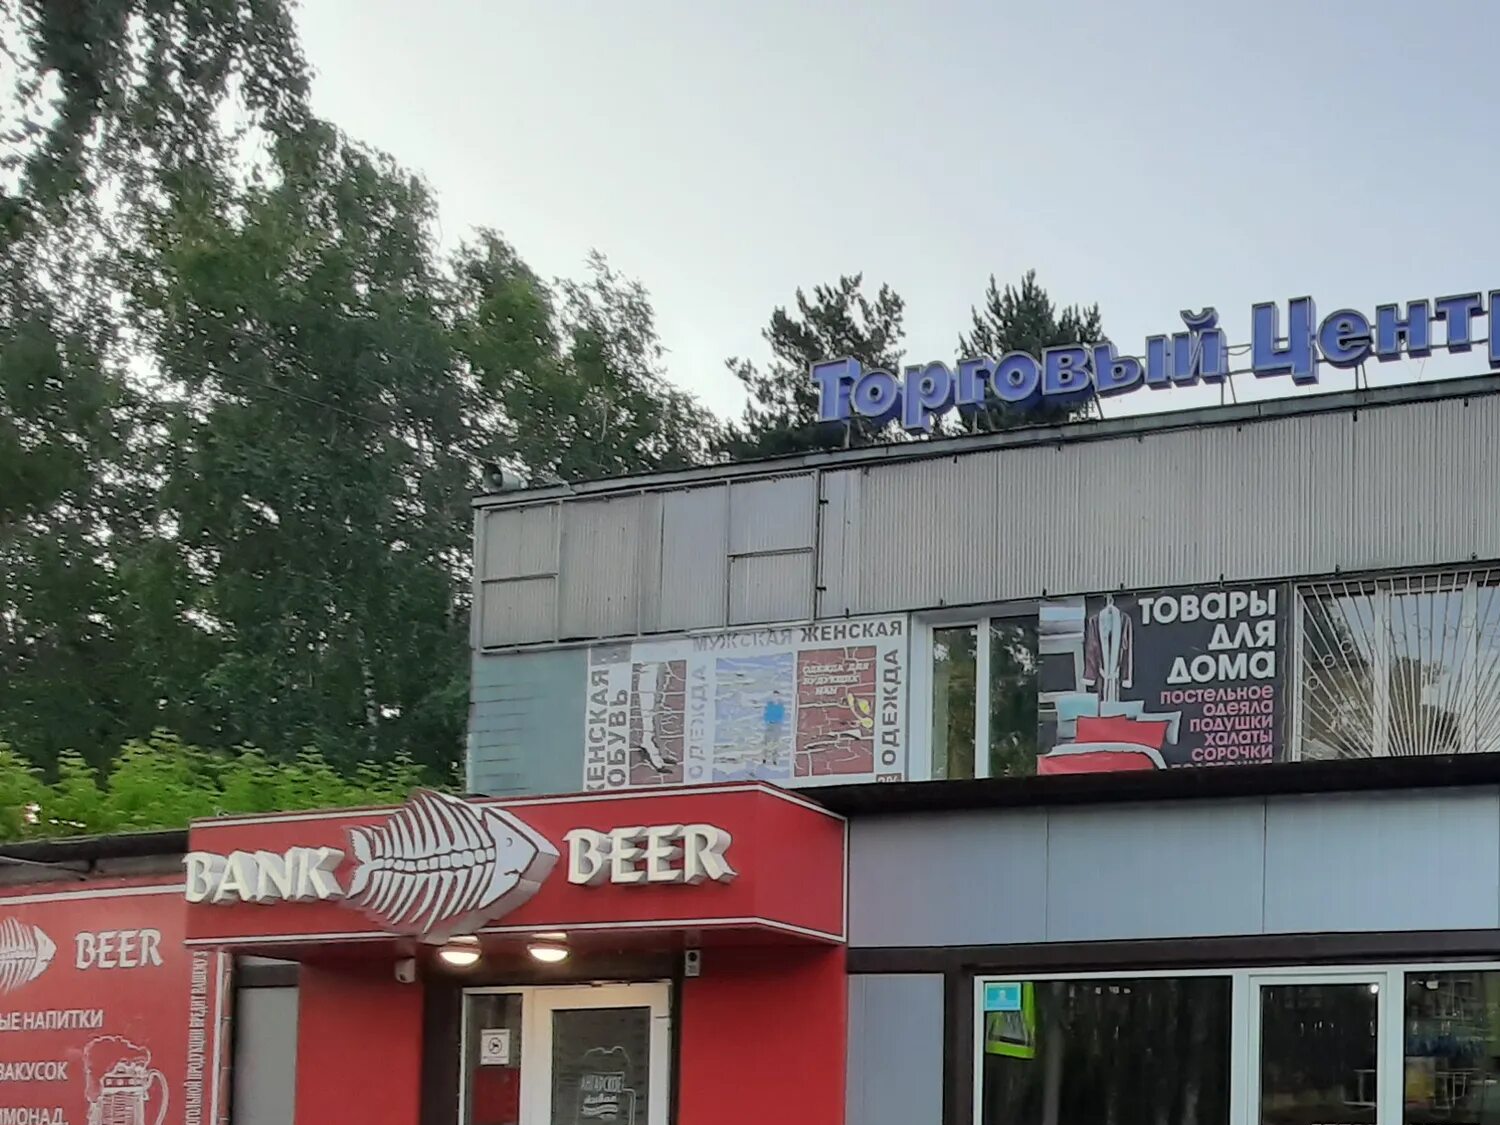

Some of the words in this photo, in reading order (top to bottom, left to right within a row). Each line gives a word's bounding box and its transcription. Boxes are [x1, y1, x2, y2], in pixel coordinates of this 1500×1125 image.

[811, 307, 1228, 433] Торговый
[692, 630, 793, 651] МУЖСКАЯ
[800, 620, 903, 643] ЖЕНСКАЯ
[688, 665, 708, 779] ОДЕЖДА
[881, 649, 899, 766] ОДЕЖДА
[607, 689, 628, 787] ОБУВЬ
[182, 848, 345, 903] BANK
[562, 824, 739, 886] BEER
[74, 928, 164, 970] BEER
[23, 1009, 104, 1030] НАПИТКИ
[189, 994, 208, 1028] ВРЕДИТ
